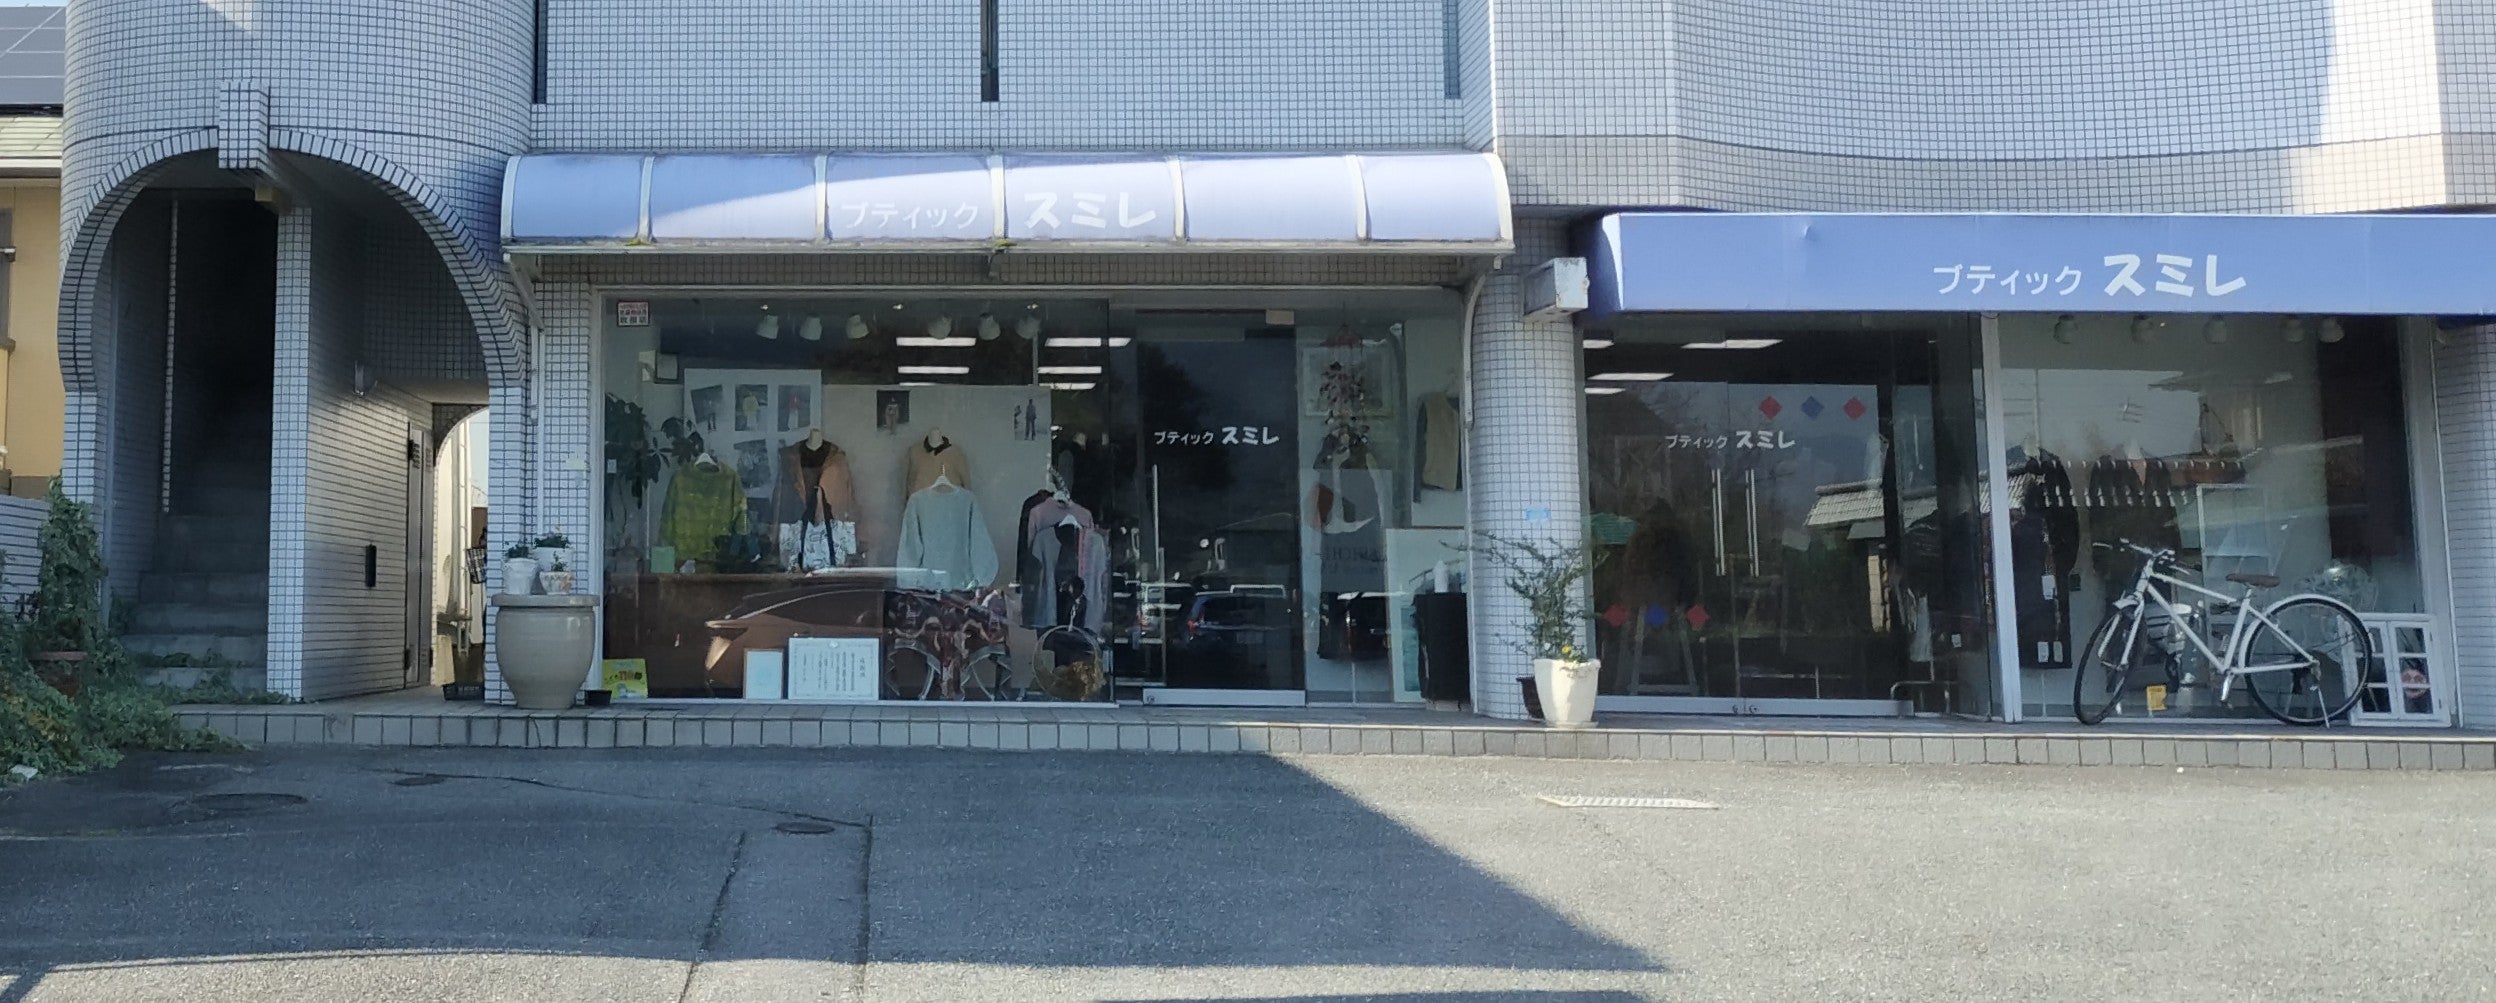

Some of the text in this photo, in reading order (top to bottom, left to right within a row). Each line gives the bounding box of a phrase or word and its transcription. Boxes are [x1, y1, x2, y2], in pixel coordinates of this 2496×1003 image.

[841, 192, 1157, 230] ブティック スミレ
[1933, 254, 2247, 298] ブティック スミレ
[1222, 426, 1280, 445] スミレ
[1736, 430, 1796, 449] スミレ
